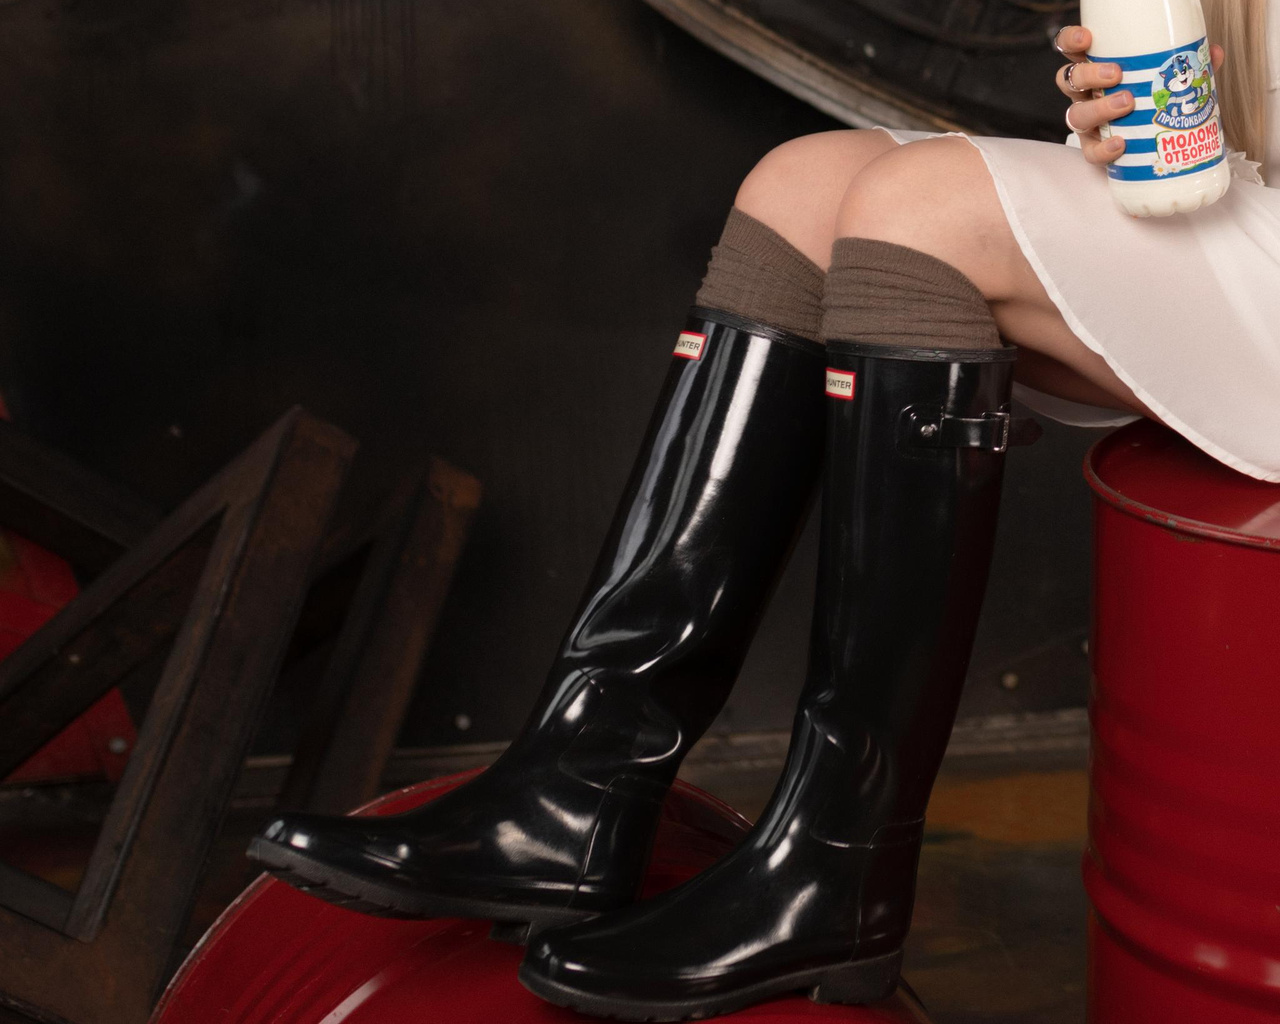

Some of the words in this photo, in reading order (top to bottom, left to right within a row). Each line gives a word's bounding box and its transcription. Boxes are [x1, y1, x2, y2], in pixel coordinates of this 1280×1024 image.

[1157, 97, 1214, 128] ПРОСТОКВАШИНО
[1161, 121, 1218, 152] МОЛОКО
[1164, 136, 1221, 165] ОТБОРНОЕ
